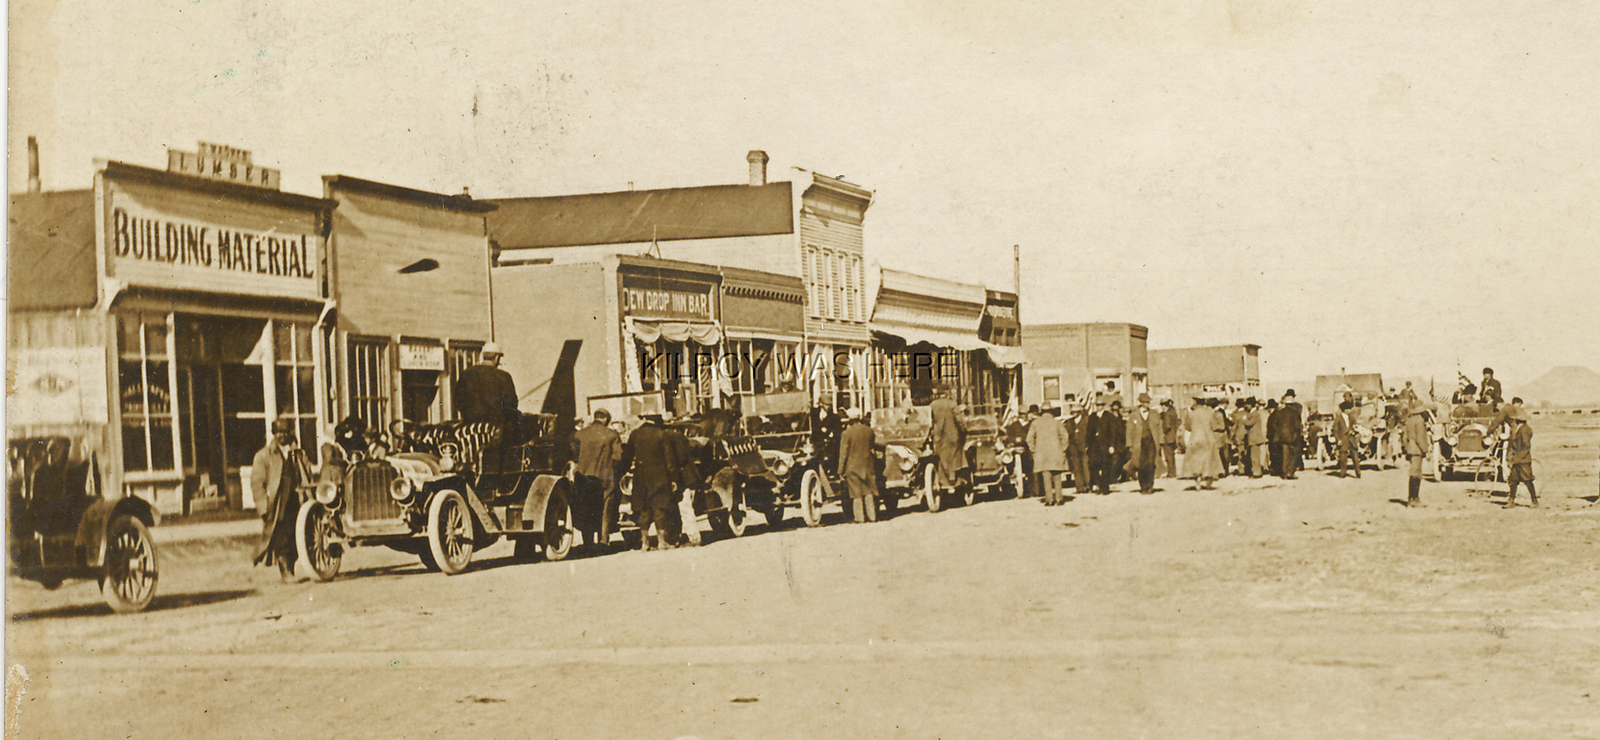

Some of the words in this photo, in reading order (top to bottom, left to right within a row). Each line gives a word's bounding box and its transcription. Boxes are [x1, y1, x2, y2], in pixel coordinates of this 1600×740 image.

[180, 152, 268, 185] LUMBER
[114, 207, 212, 266] BUILDING
[218, 229, 314, 279] MATERIAL
[623, 287, 645, 311] DEW
[646, 291, 670, 311] DROP
[672, 293, 687, 312] INN
